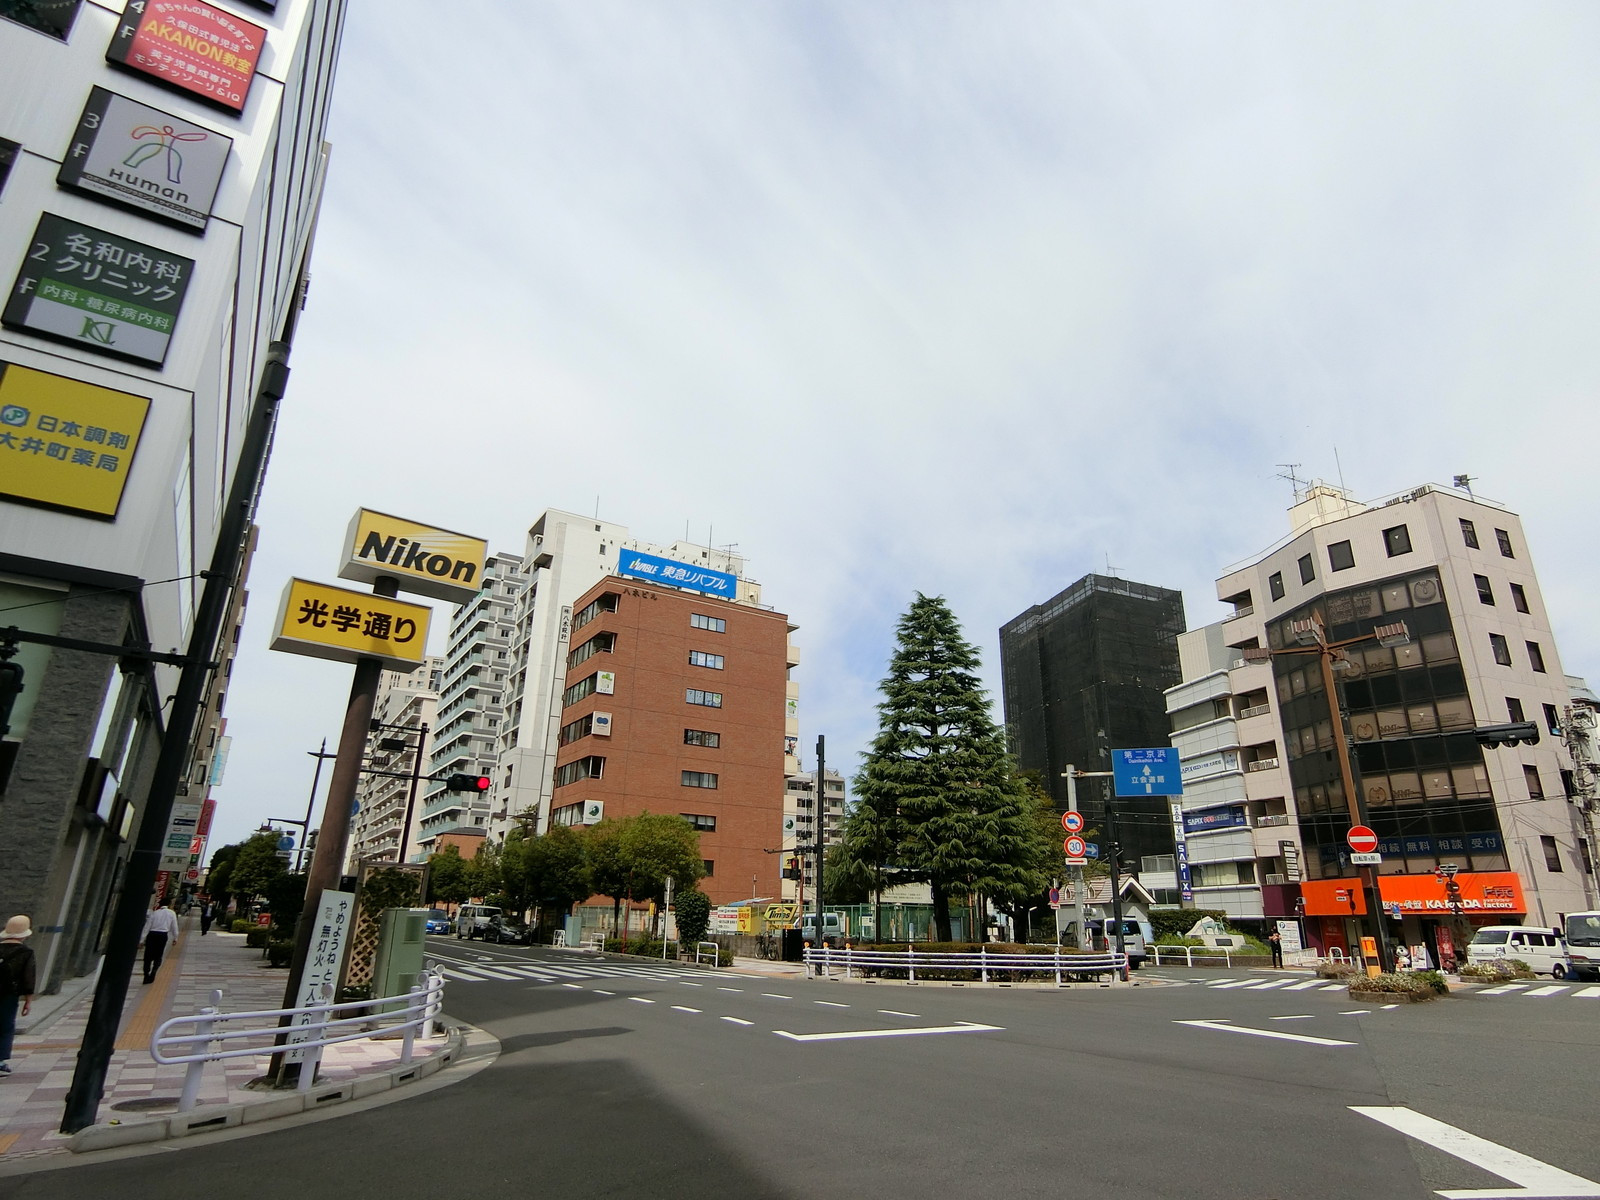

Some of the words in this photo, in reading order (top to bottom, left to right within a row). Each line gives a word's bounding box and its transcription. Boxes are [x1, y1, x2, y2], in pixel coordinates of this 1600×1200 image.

[130, 1, 145, 14] 4
[120, 25, 136, 39] F
[165, 15, 241, 53] 久保田式育児法
[144, 20, 252, 75] AKANON教室
[84, 112, 101, 129] 3
[73, 144, 90, 158] F
[108, 168, 190, 204] Human
[30, 242, 50, 262] 2
[65, 233, 182, 284] 名和内科
[19, 277, 38, 294] F
[55, 256, 177, 302] クリニック
[43, 284, 170, 330] 内科・糖尿病内科
[37, 414, 130, 450] 日本調剤
[0, 431, 120, 473] 大井町薬局
[358, 530, 477, 583] Nikon
[660, 565, 728, 590] 東急リバブル
[297, 598, 417, 643] 光学通り
[1123, 749, 1167, 759] 第二京浜
[1131, 775, 1165, 784] 立会道路
[1069, 841, 1082, 852] 30
[1406, 840, 1430, 851] 無料
[1438, 838, 1464, 850] 相談
[1471, 837, 1497, 848] 受付
[1177, 845, 1190, 891] SAPIX
[1483, 901, 1514, 909] factory
[327, 900, 348, 964] やめようね
